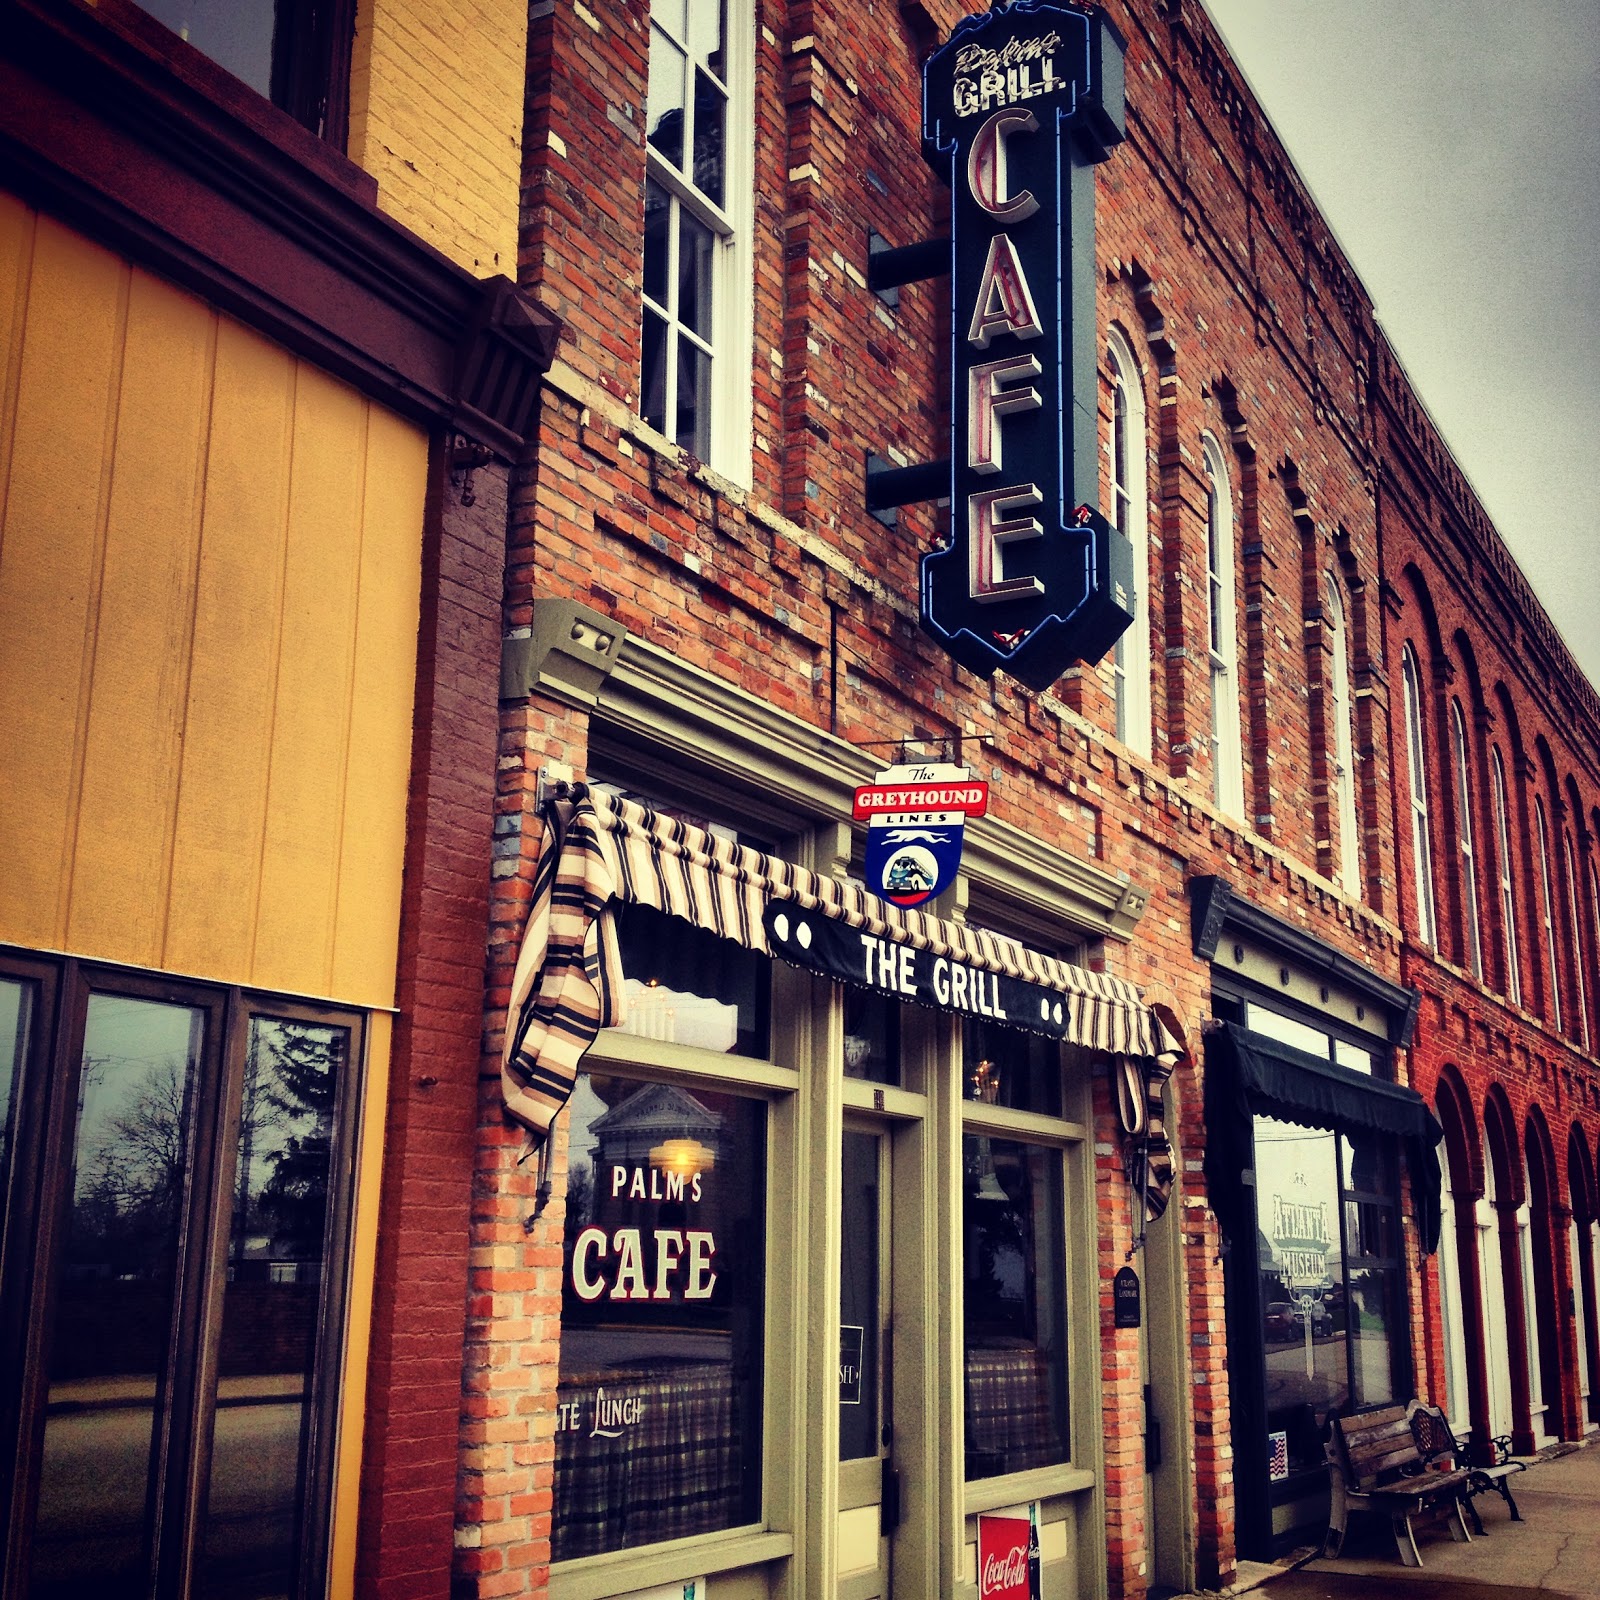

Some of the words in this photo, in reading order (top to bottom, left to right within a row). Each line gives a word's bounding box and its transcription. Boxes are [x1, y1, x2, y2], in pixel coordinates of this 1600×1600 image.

[953, 57, 1067, 117] GRILL
[967, 108, 1045, 604] CAFE
[908, 766, 935, 781] The
[857, 789, 984, 807] GREYHOUND
[886, 814, 948, 823] LINES
[860, 934, 919, 996] THE
[933, 957, 1008, 1020] GRILL
[611, 1165, 703, 1203] PALMS
[1272, 1194, 1332, 1245] ATLANTA
[571, 1227, 718, 1300] CAFE
[1280, 1249, 1327, 1279] MUSEUM
